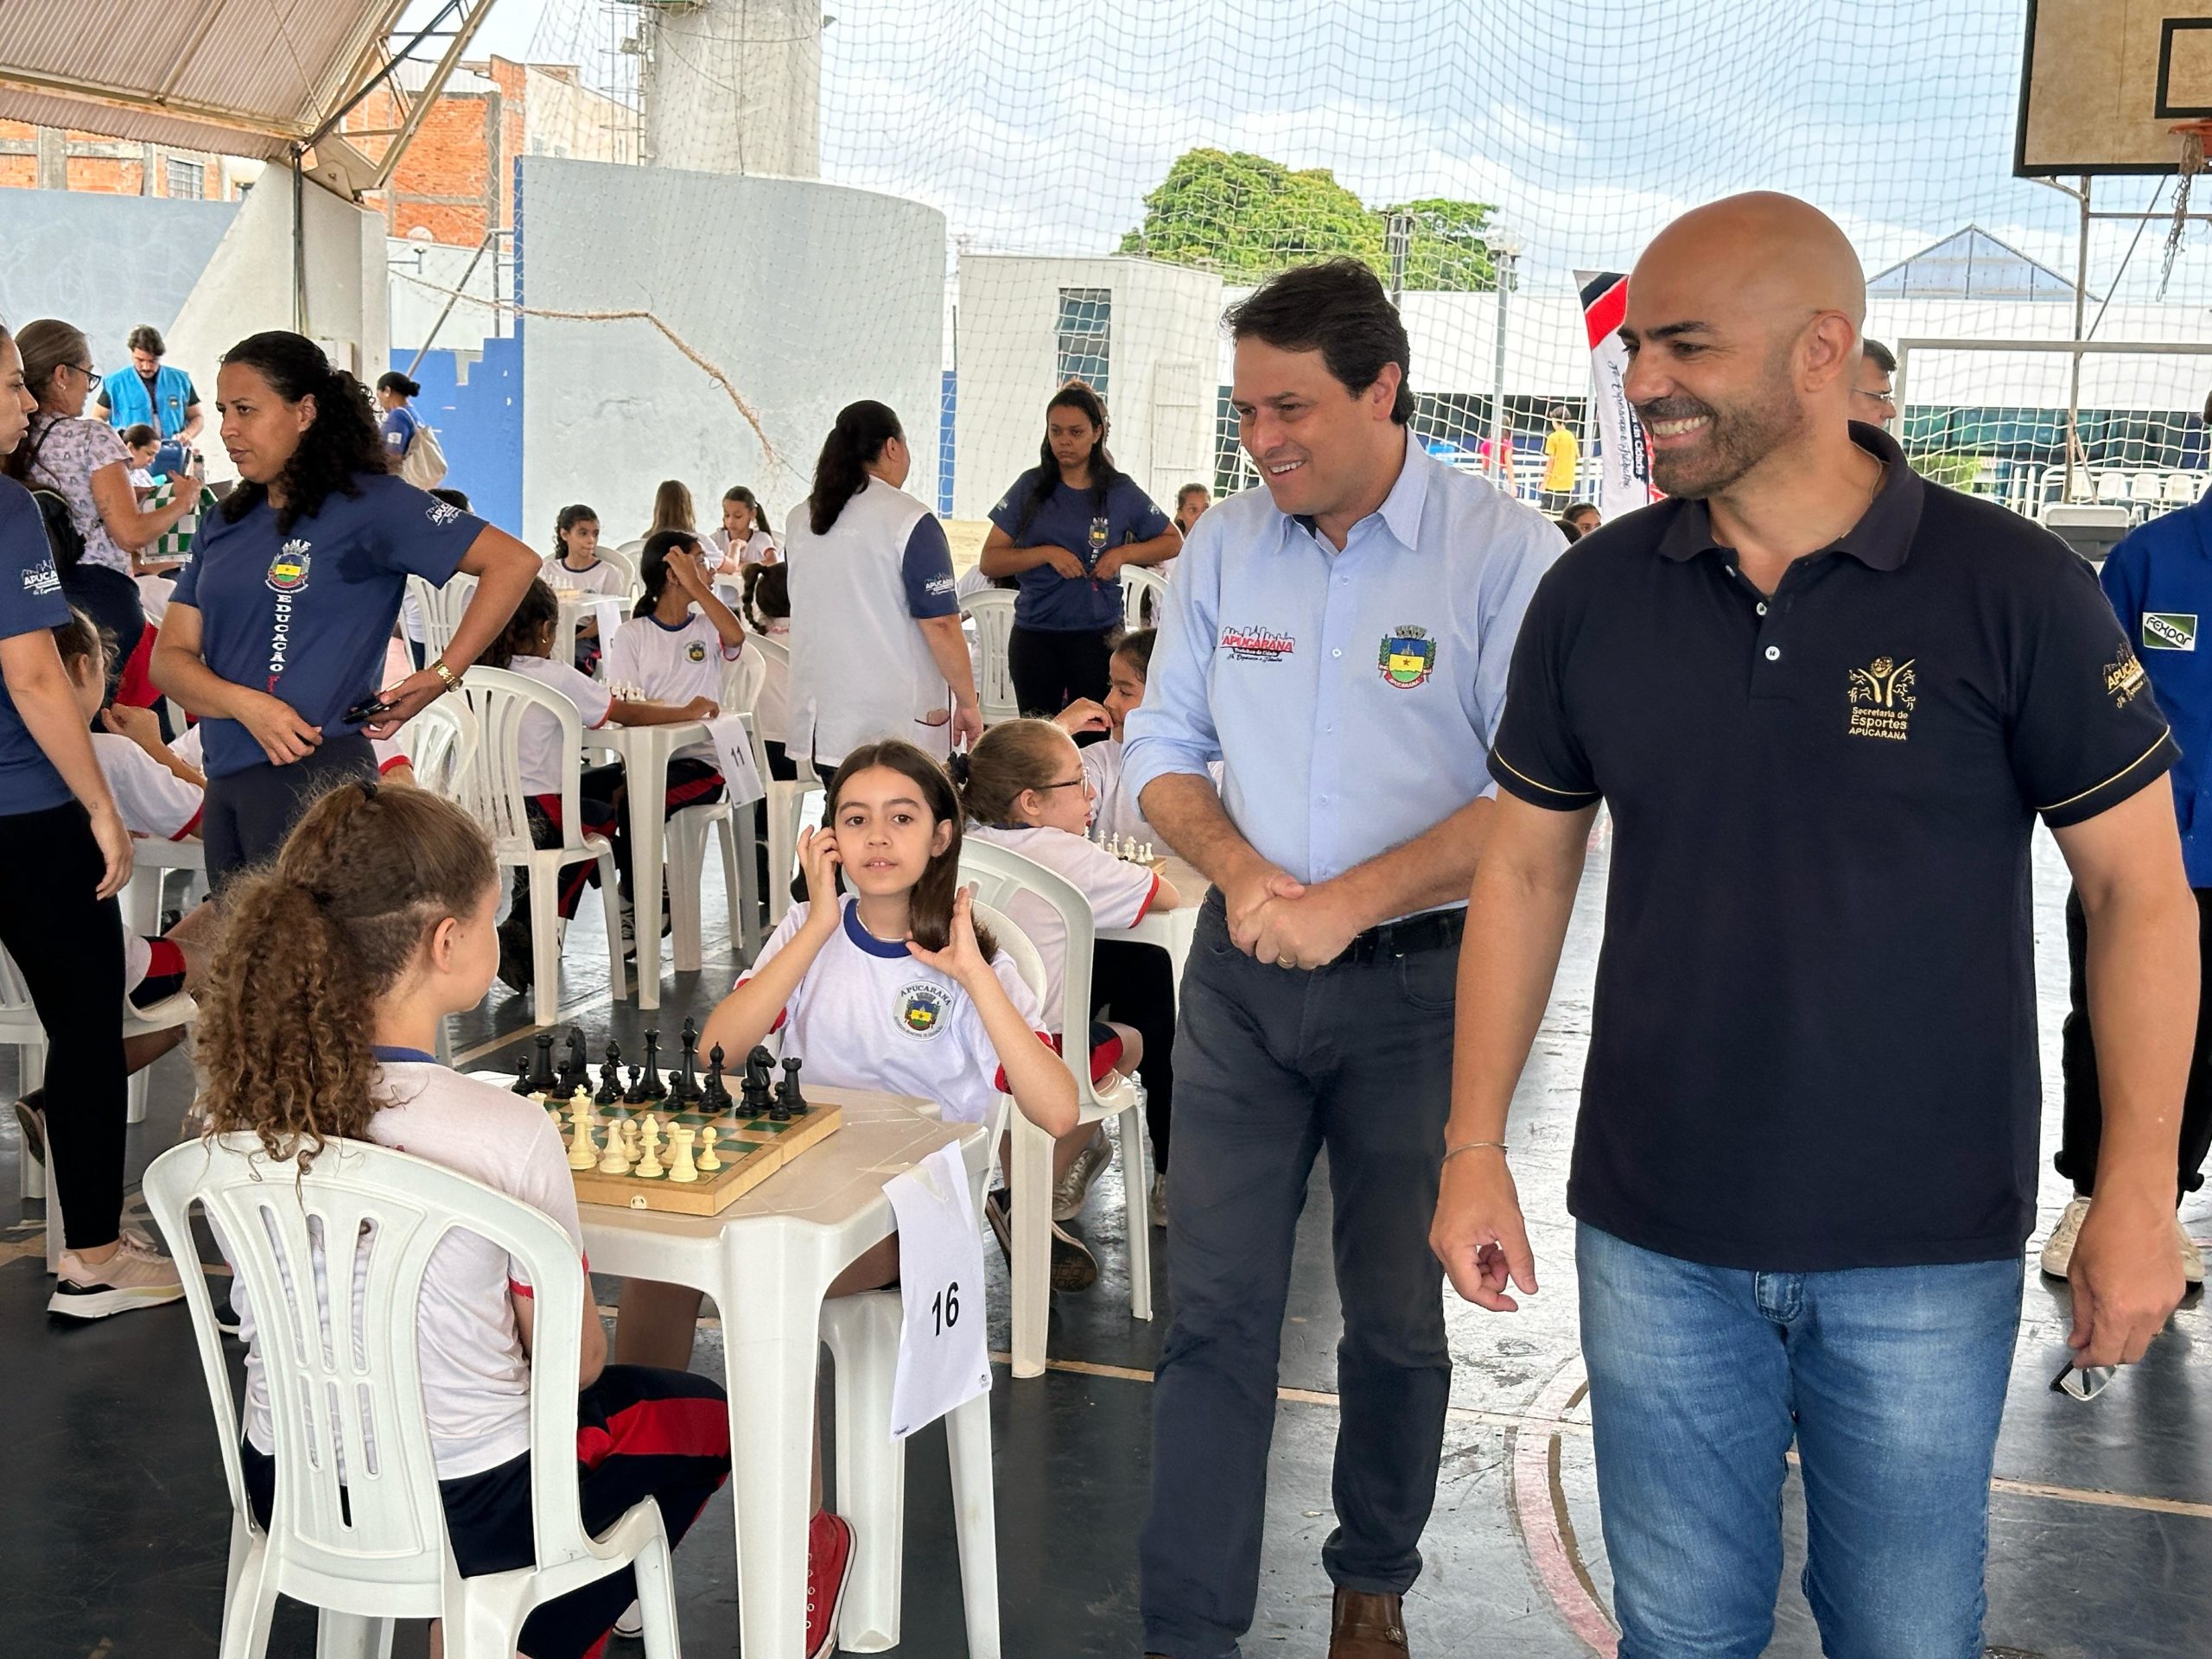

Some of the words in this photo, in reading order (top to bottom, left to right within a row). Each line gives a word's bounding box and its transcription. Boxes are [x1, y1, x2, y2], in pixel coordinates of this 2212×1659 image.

[270, 594, 292, 672] EDUCAÇÃO
[1222, 635, 1293, 652] APUCARANA
[1852, 707, 1895, 718] Secretaria
[1851, 715, 1908, 730] Esportes
[1848, 727, 1907, 741] APUCARANA
[731, 746, 745, 767] 11
[900, 985, 951, 1006] APUCARANA
[932, 1281, 959, 1337] 16
